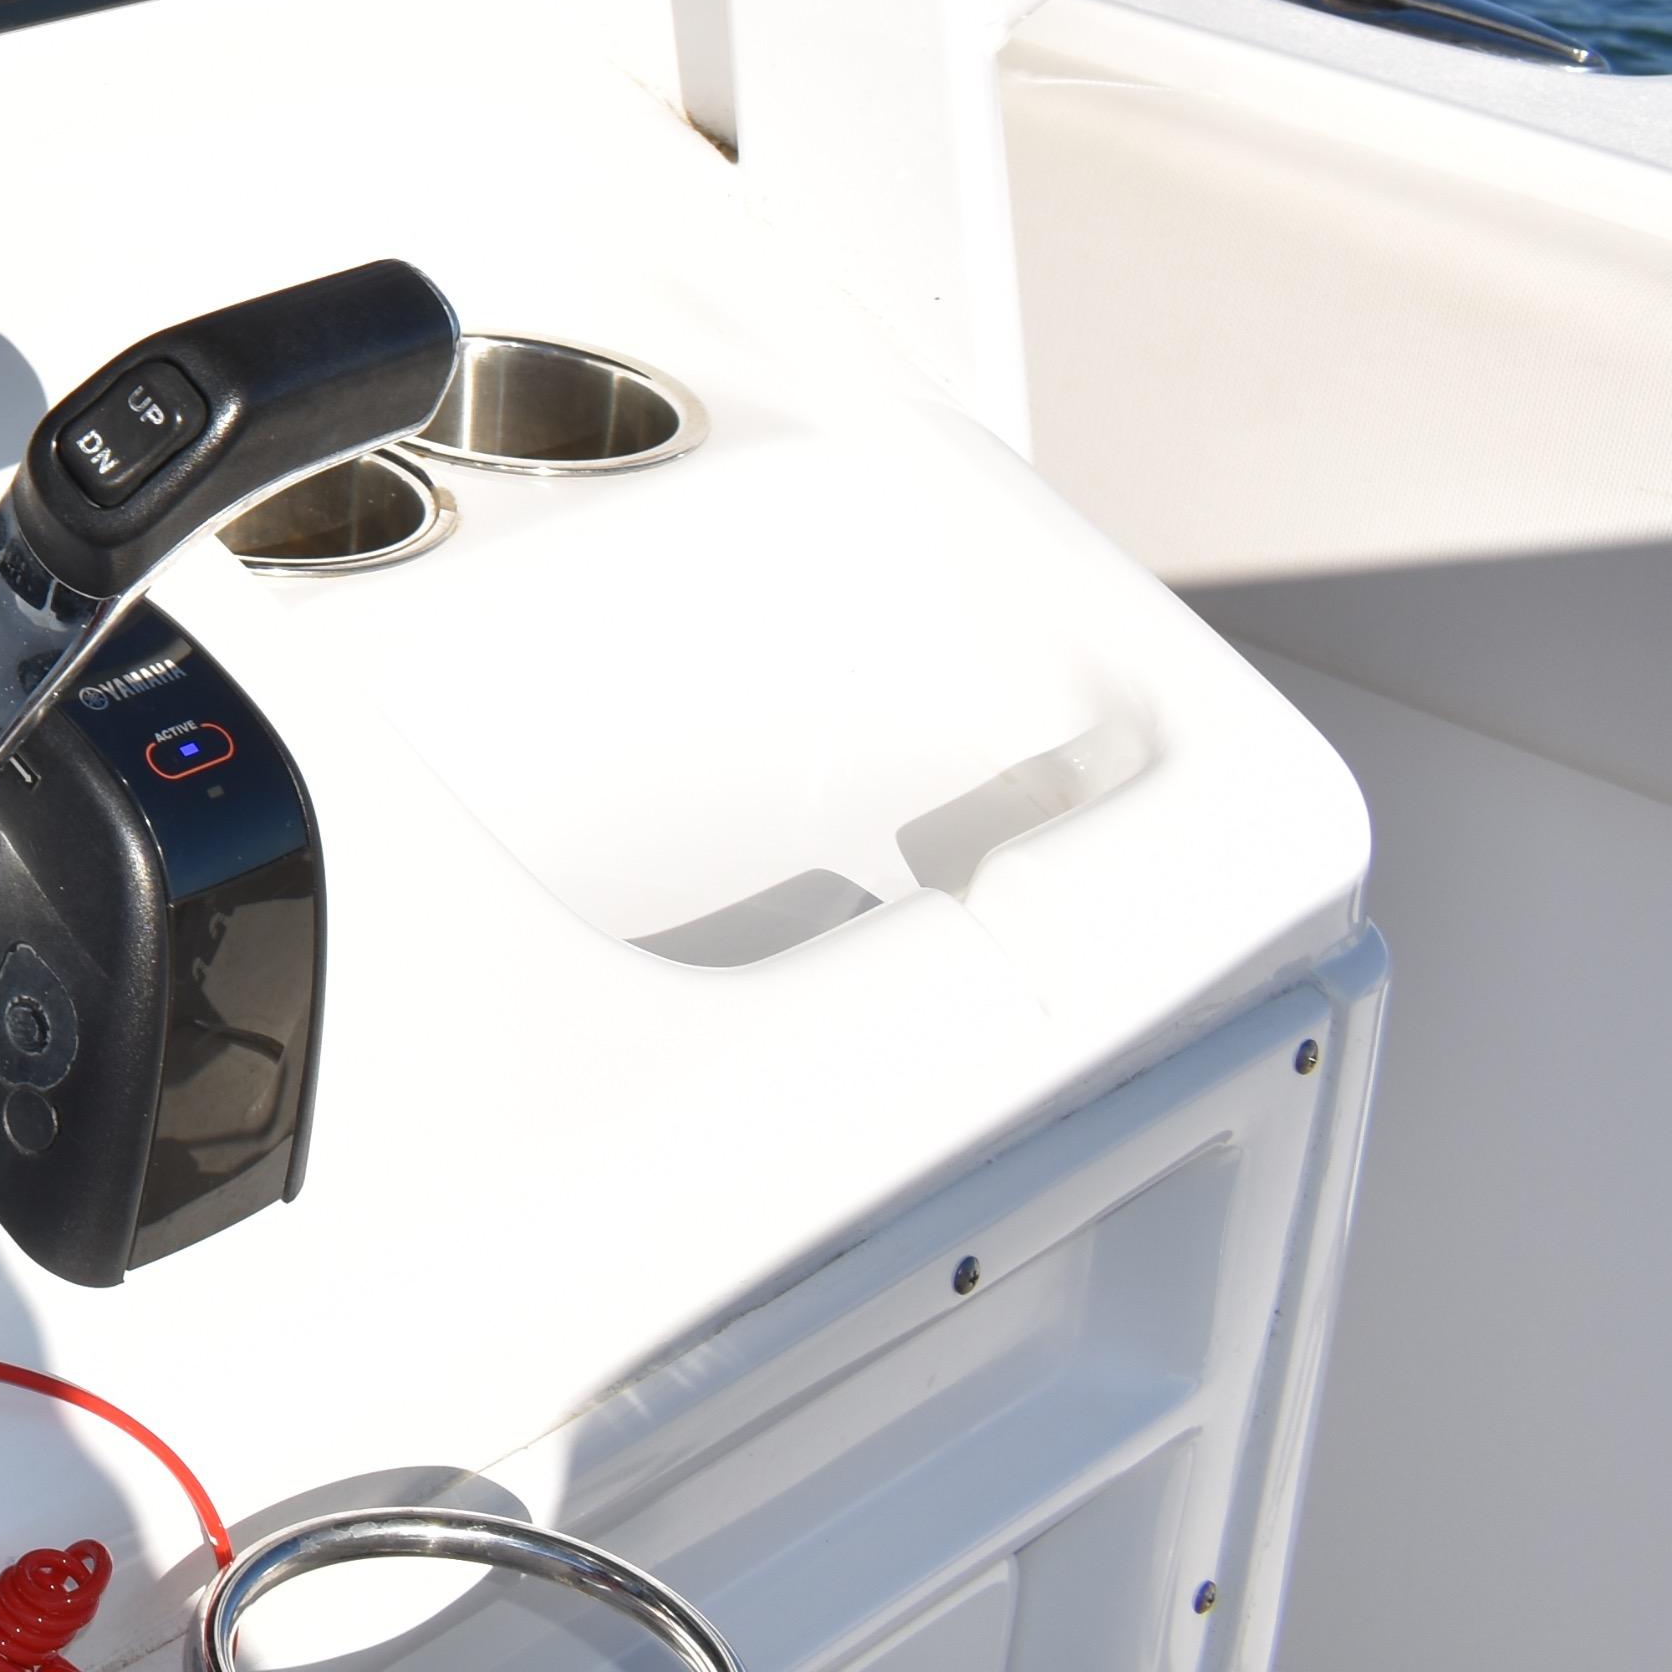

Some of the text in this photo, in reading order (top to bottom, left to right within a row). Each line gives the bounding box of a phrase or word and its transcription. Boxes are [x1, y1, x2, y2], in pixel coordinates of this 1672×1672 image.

[127, 384, 166, 426] UP
[76, 427, 122, 475] DN
[99, 658, 188, 702] YAMAHA
[153, 720, 199, 744] ACTIVE
